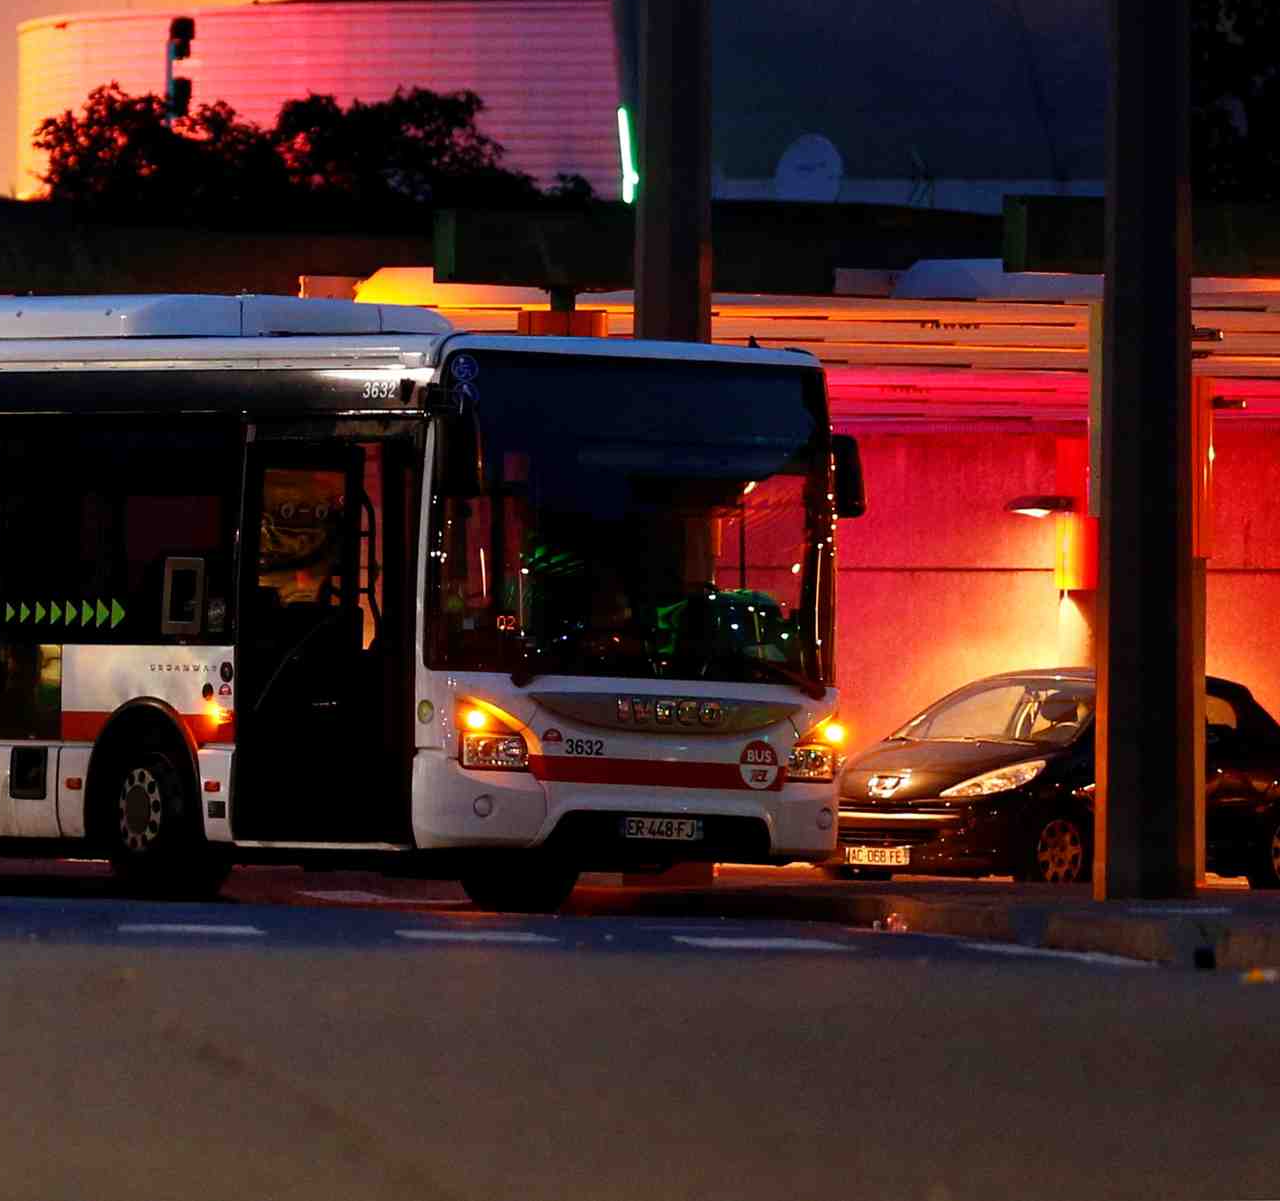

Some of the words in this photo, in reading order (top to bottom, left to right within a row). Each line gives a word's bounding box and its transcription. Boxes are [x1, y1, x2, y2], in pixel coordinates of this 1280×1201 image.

[362, 381, 396, 399] 3632
[565, 738, 605, 756] 3632
[747, 749, 773, 763] BUS
